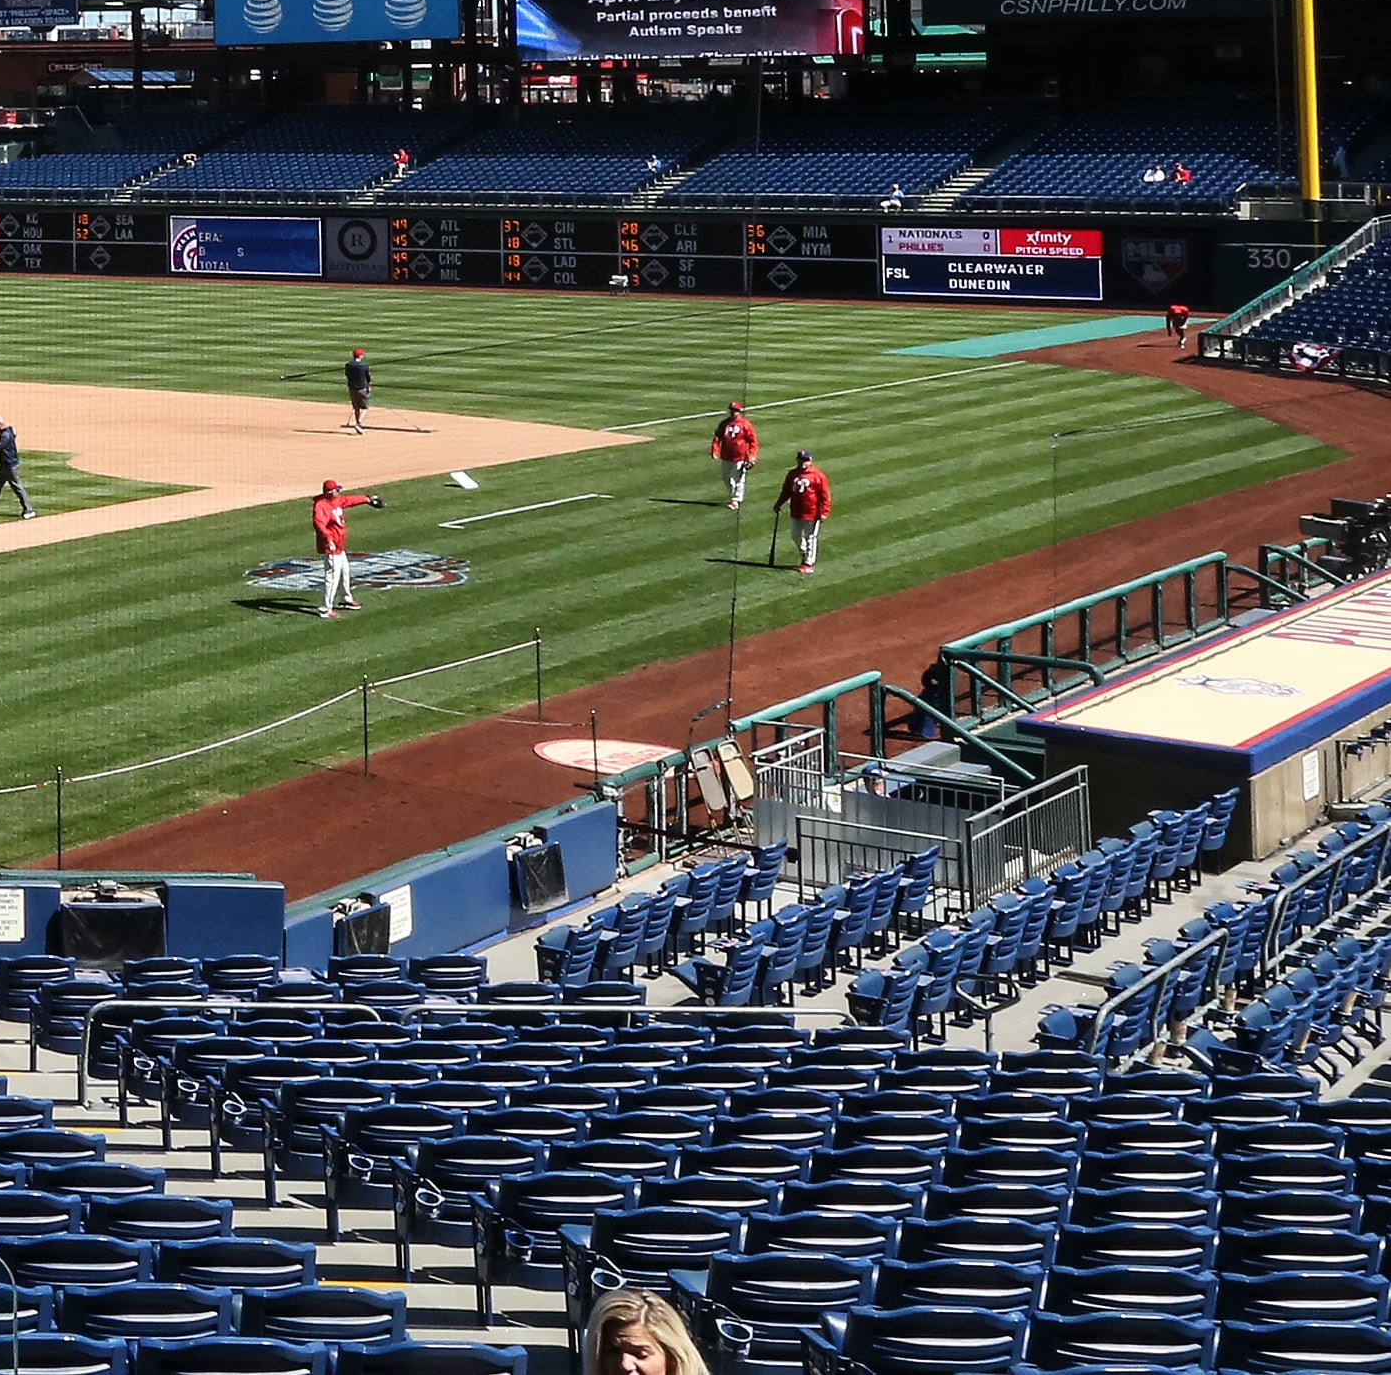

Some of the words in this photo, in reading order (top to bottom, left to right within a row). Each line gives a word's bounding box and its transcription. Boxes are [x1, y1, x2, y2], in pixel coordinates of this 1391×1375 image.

[597, 9, 645, 23] Partial
[649, 7, 718, 22] proceeds
[724, 5, 778, 19] benefit
[628, 24, 682, 38] Autism
[686, 23, 744, 37] Speaks
[115, 215, 134, 225] SEA
[440, 220, 461, 232] ATL
[23, 227, 42, 238] HOU
[554, 221, 575, 233] CIN
[621, 222, 639, 235] 28
[674, 223, 698, 236] CLE
[803, 225, 828, 239] MIA
[115, 229, 134, 240] LAA
[198, 232, 223, 243] ERA:
[393, 235, 408, 246] 45
[441, 235, 458, 247] PIT
[898, 228, 963, 240] NATIONALS
[983, 231, 991, 240] 0
[1025, 231, 1073, 246] xfinity
[23, 243, 42, 254] OAK
[554, 238, 576, 250] STL
[621, 240, 639, 252] 46
[676, 240, 697, 254] ARI
[748, 241, 765, 254] 34
[801, 242, 831, 256] NYM
[898, 241, 945, 253] PHILLIES
[1015, 245, 1045, 256] PITCH
[1047, 246, 1084, 257] SPEED
[24, 257, 42, 269] TEX
[439, 253, 462, 265] CHC
[554, 256, 577, 268] LAD
[1247, 247, 1291, 270] 330
[199, 261, 232, 271] TOTAL
[679, 259, 695, 272] SF
[886, 267, 911, 280] FSL
[948, 262, 1045, 276] CLEARWATER
[554, 272, 577, 285] COL
[679, 275, 696, 288] SD
[949, 278, 1011, 291] DUNEDIN
